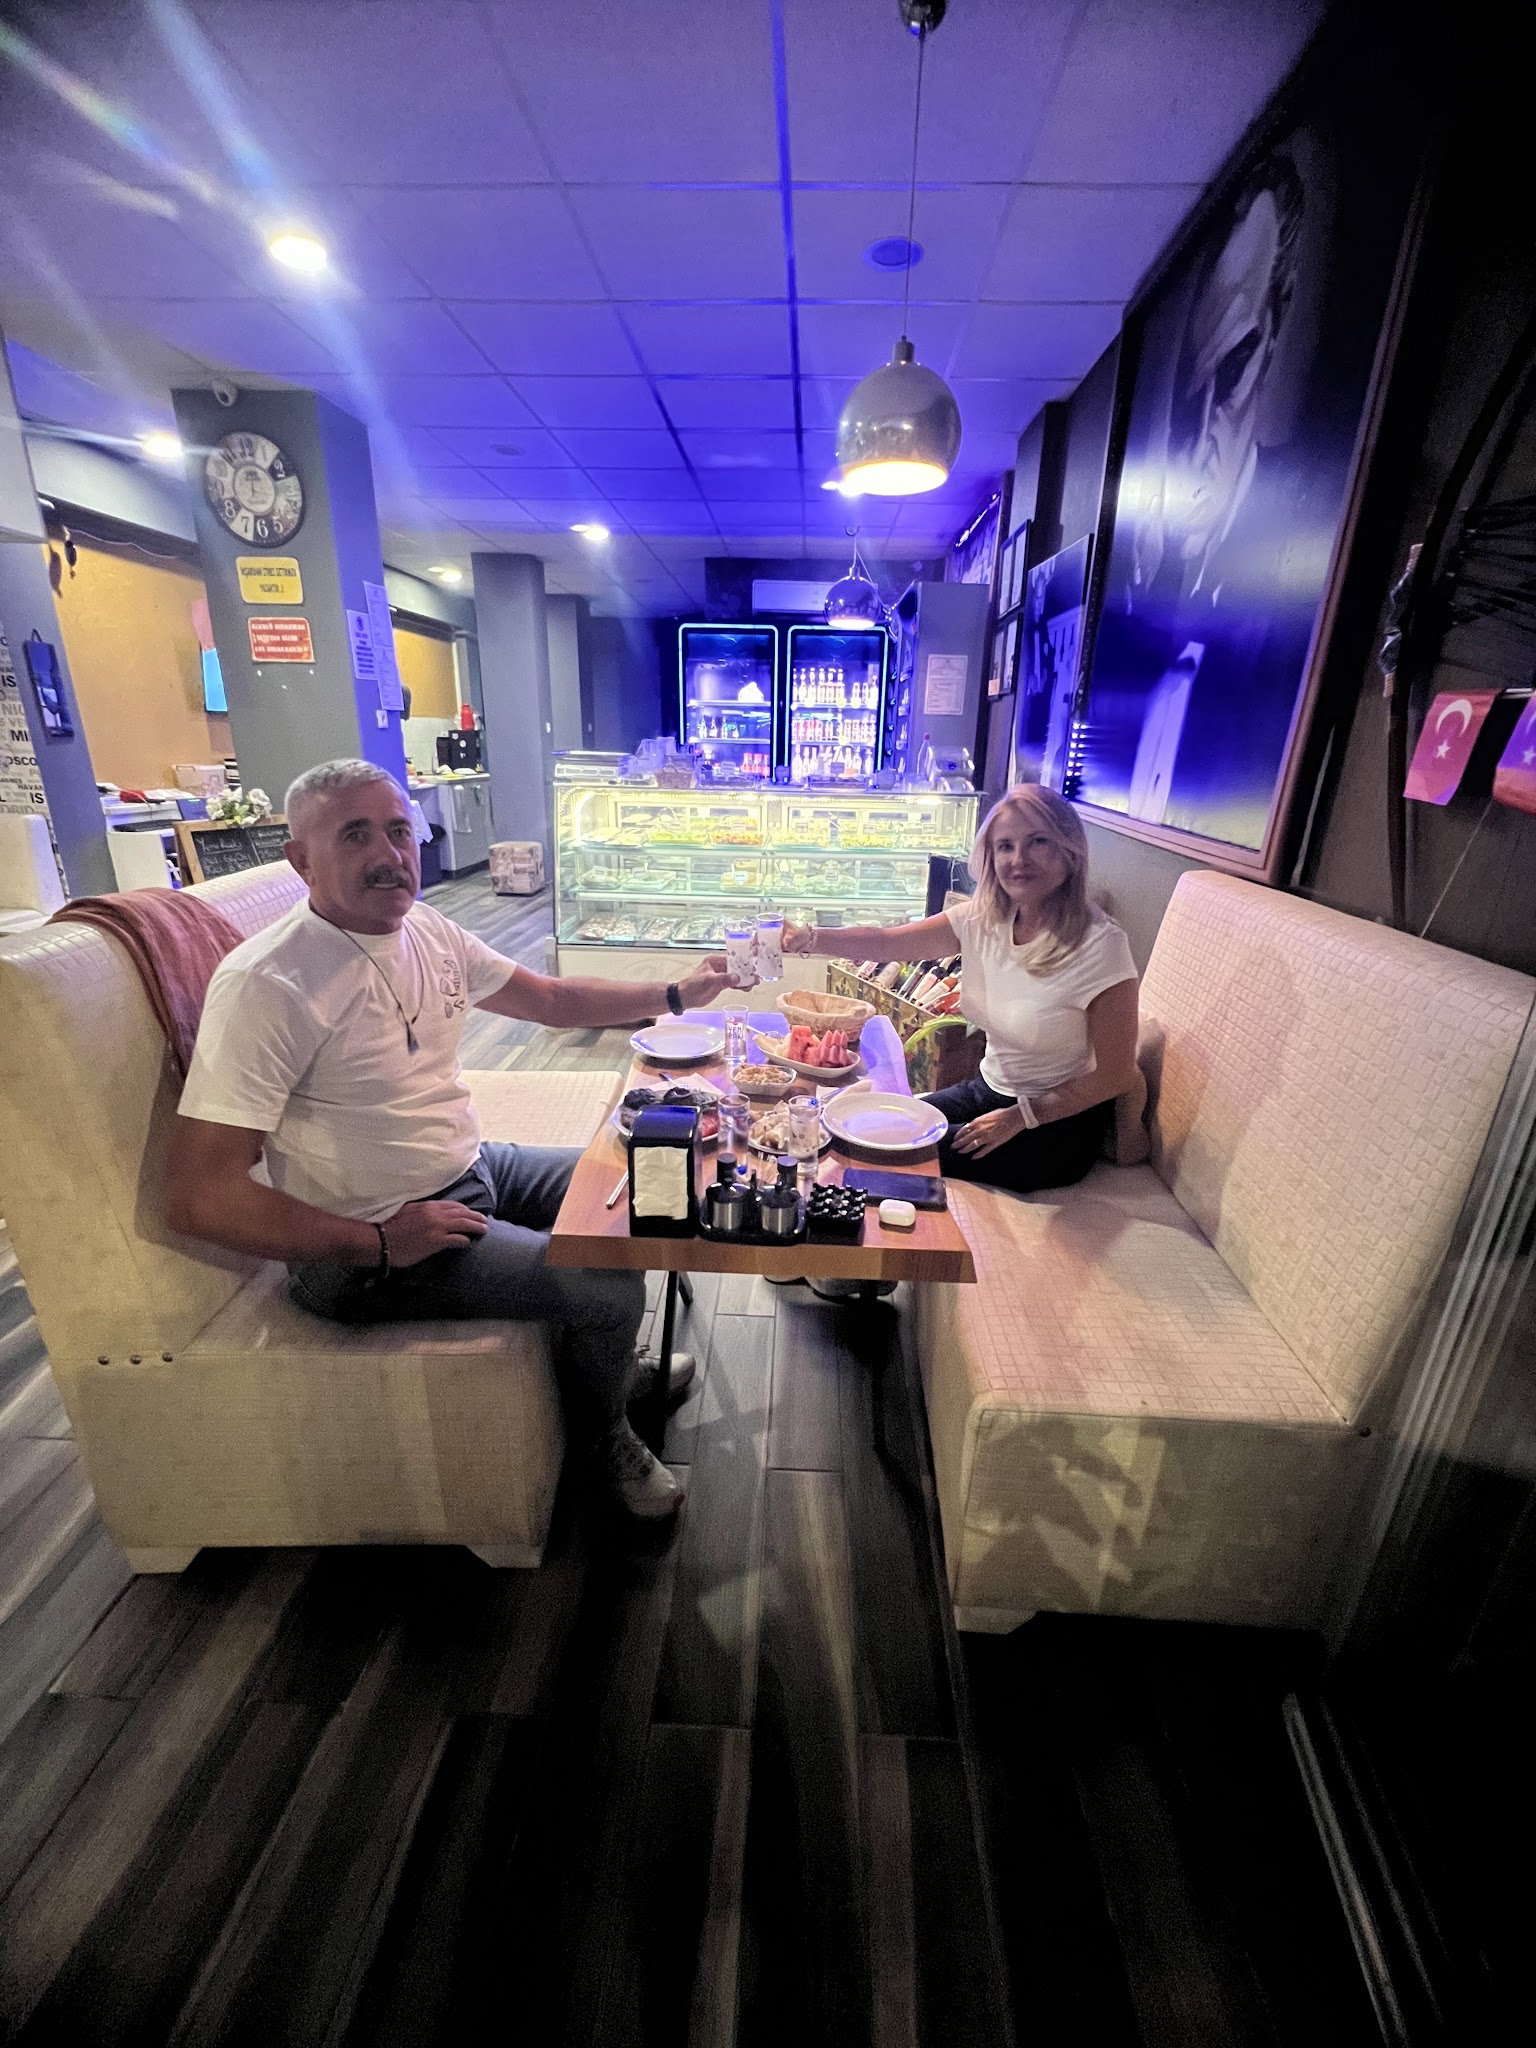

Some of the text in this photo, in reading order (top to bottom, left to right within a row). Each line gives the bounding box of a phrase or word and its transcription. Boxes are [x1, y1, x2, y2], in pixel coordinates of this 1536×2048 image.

[273, 459, 285, 478] 2
[224, 500, 236, 518] 8
[241, 516, 249, 533] 7
[256, 518, 269, 538] 6
